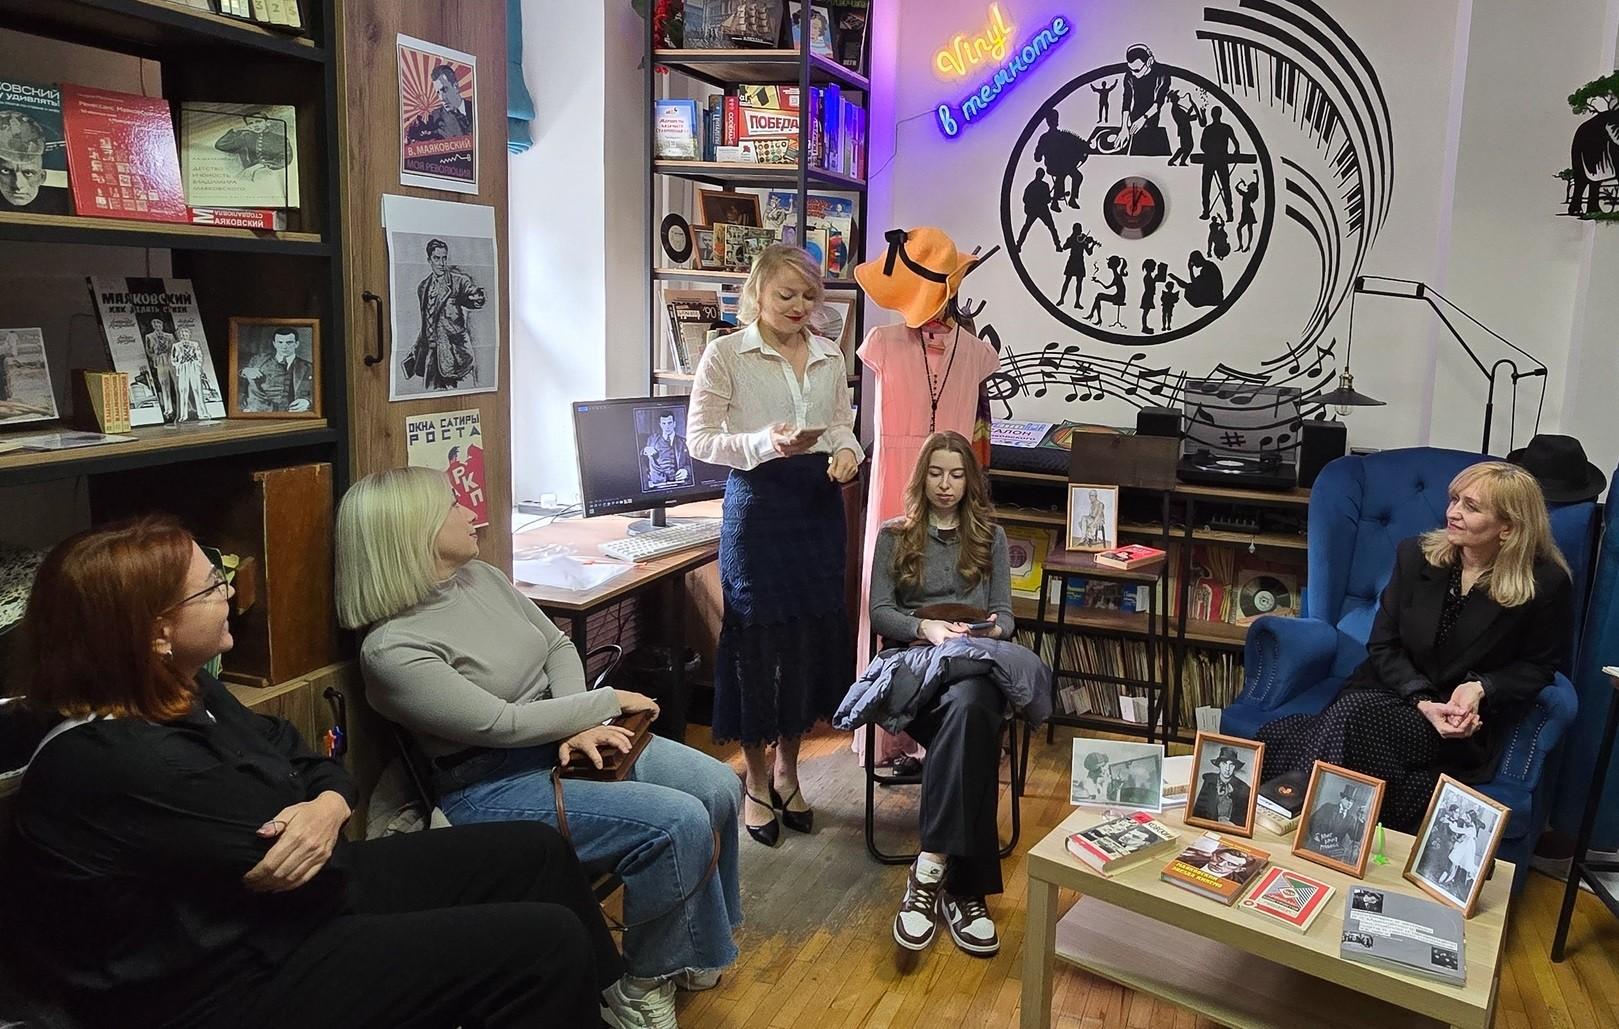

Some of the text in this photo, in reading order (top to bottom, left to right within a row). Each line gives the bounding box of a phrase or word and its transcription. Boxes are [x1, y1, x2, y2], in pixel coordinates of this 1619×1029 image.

[271, 3, 280, 12] 2
[936, 2, 1010, 75] Vinyl
[962, 17, 1069, 121] темноте
[749, 115, 799, 132] ПОБЕДА
[416, 139, 471, 155] МАЯКОВСКИЙ
[407, 159, 425, 171] МОЯ
[101, 291, 192, 305] МАЯКОВСКИЙ
[408, 413, 480, 433] ОКНА САТИРЫ
[991, 427, 1032, 436] АЛОН
[409, 425, 481, 446] РОСТА
[452, 465, 484, 507] РКП
